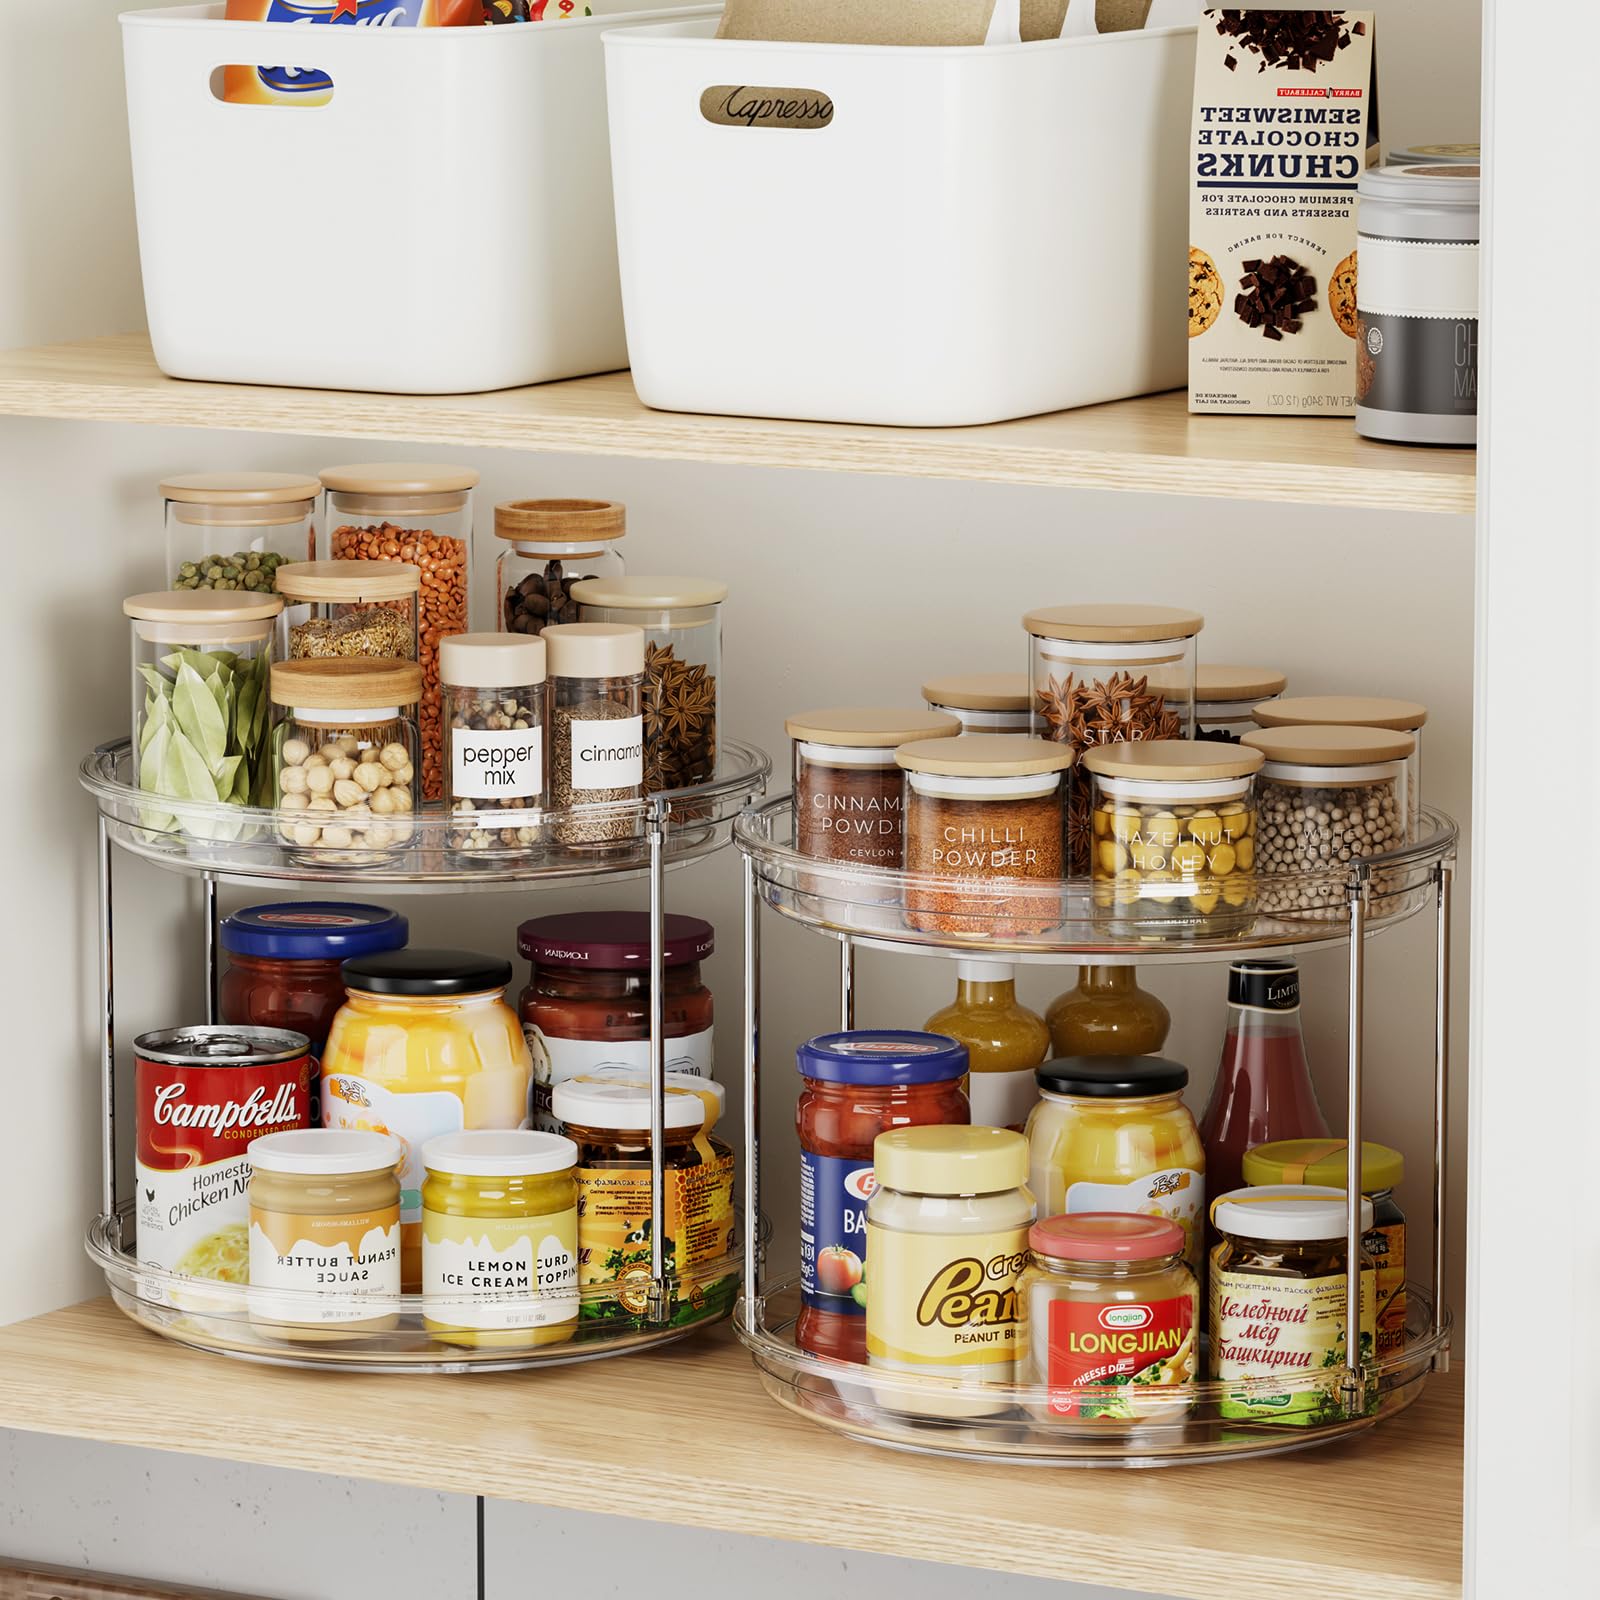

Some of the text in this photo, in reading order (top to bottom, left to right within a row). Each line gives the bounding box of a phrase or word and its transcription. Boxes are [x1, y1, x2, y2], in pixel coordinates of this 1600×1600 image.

[463, 745, 534, 769] pepper
[484, 767, 516, 785] mix
[813, 793, 903, 812] CINNAM
[943, 826, 1024, 843] CHILLI
[1119, 828, 1233, 847] HAZELNUT
[849, 848, 895, 857] CEYLON
[932, 848, 1038, 867] POWDER
[1133, 855, 1216, 871] HONEY
[153, 1083, 298, 1138] Campbell's
[168, 1186, 230, 1226] Chicken
[468, 1260, 527, 1272] LEMON
[537, 1254, 569, 1269] CURD
[442, 1273, 464, 1286] ICE
[471, 1276, 529, 1288] CREAM
[1108, 1313, 1143, 1323] longjian
[1219, 1294, 1309, 1324] Целебный
[954, 1331, 1000, 1344] PEANUT
[1069, 1327, 1181, 1354] LONGJIAN
[1238, 1321, 1280, 1347] мёд
[1217, 1337, 1313, 1369] Башкирии
[1073, 1366, 1107, 1386] CHEESE
